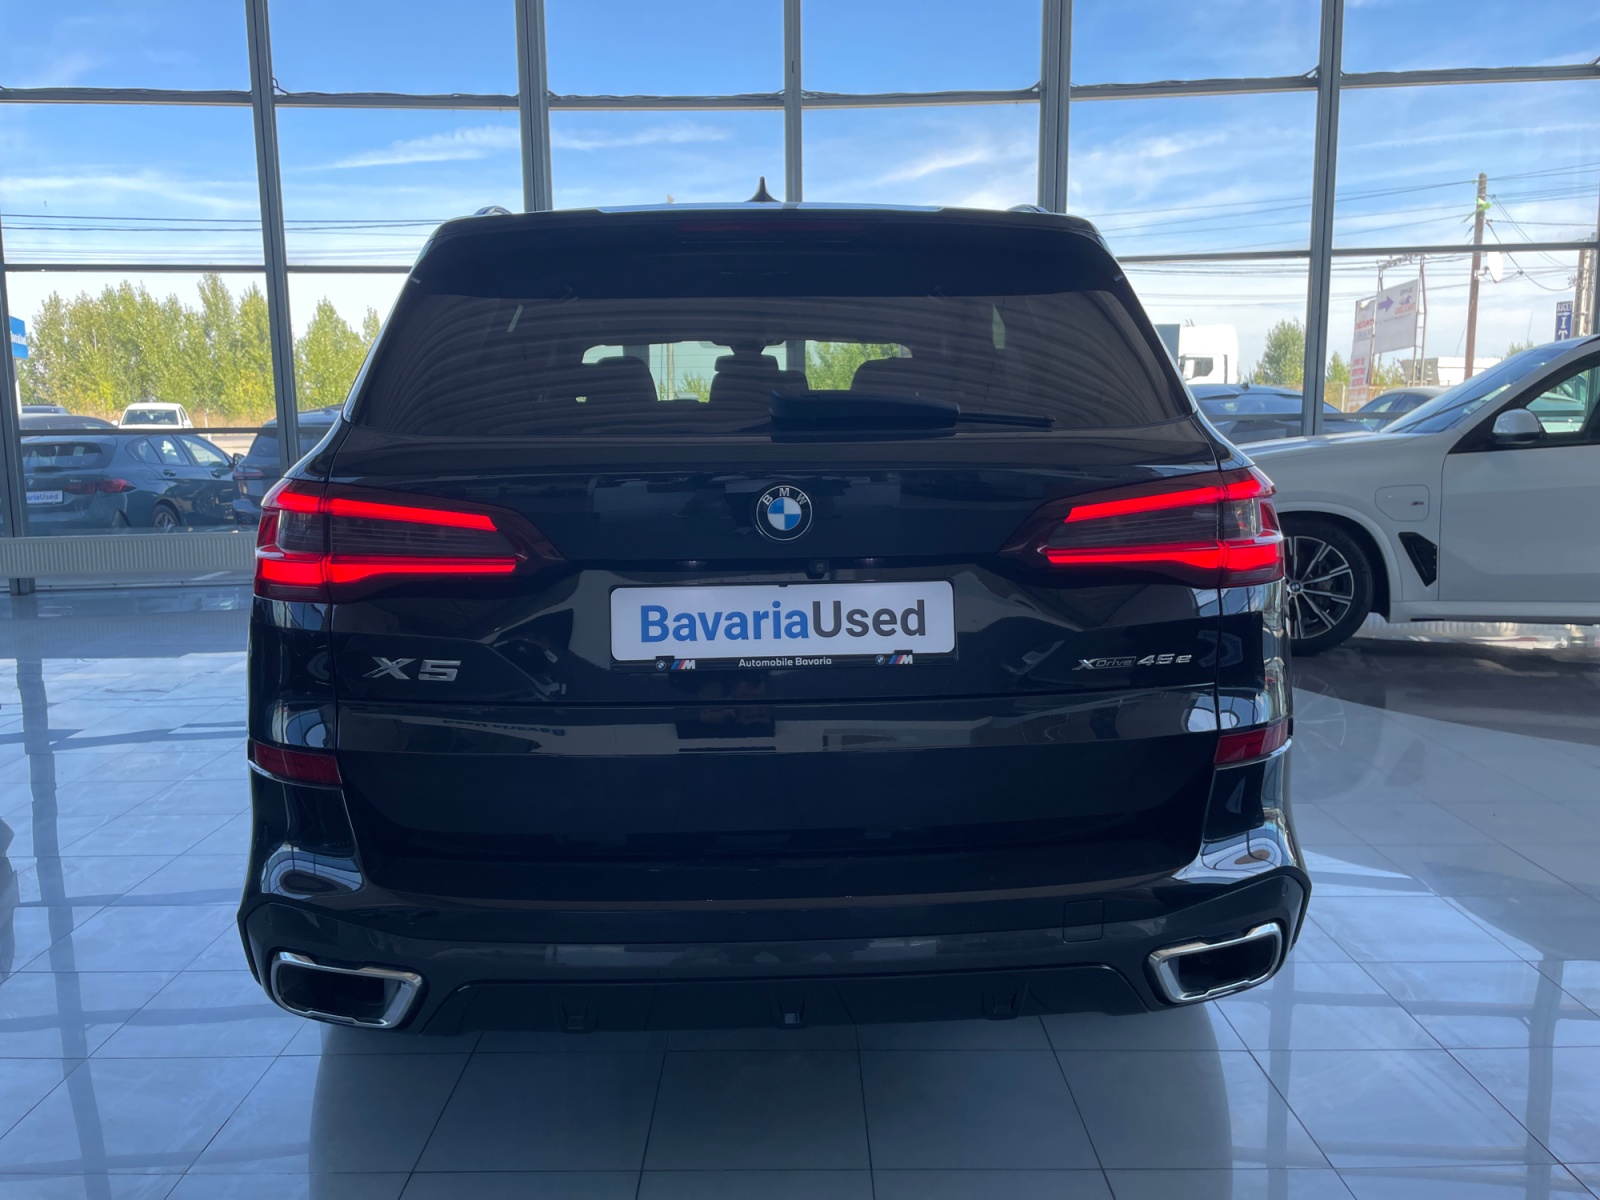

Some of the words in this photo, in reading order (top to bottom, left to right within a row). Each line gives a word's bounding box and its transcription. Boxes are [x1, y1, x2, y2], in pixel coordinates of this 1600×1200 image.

[26, 493, 59, 501] ariaUsed
[761, 488, 807, 505] BMW
[640, 599, 927, 643] BavariaUsed
[362, 656, 462, 682] X5
[738, 657, 793, 667] Automobile
[795, 656, 832, 666] Bavaria
